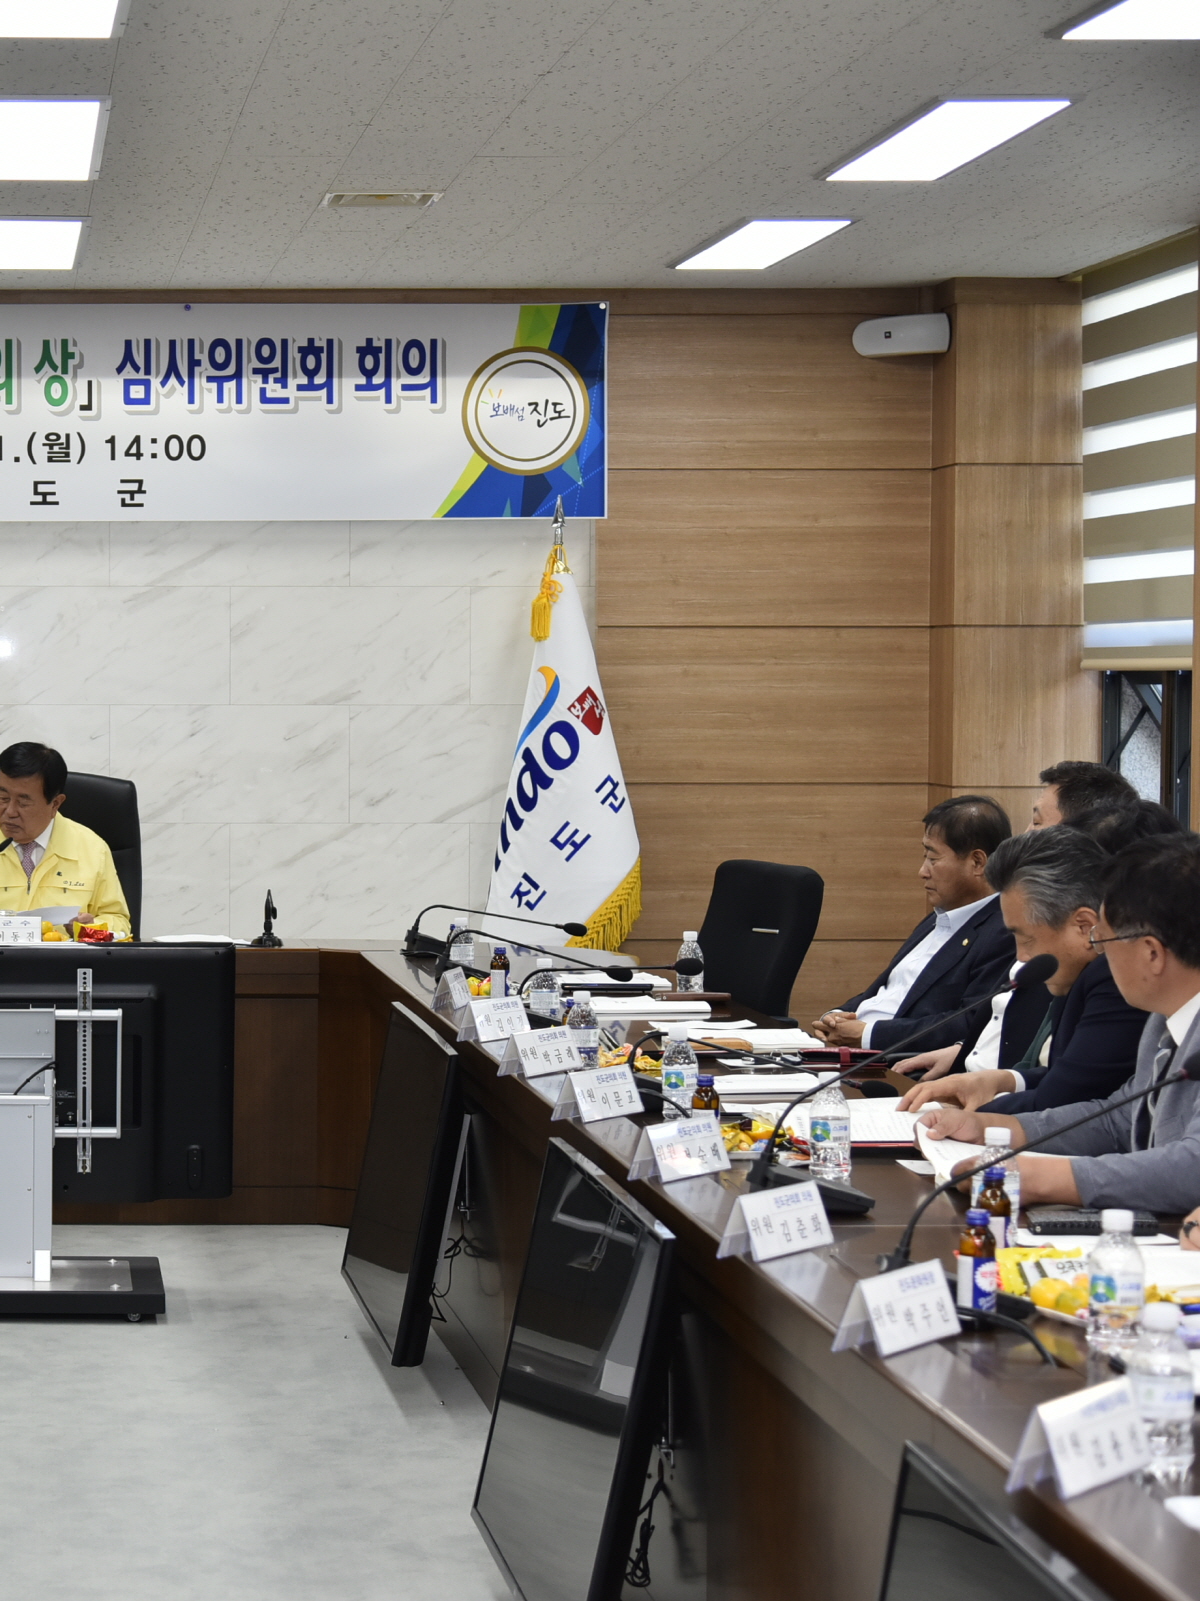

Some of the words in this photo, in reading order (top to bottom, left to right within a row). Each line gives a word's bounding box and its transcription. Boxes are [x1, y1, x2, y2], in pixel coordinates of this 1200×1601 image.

[34, 337, 94, 412] 상」
[116, 337, 337, 407] 심사위원회
[355, 337, 440, 406] 회의
[490, 402, 525, 422] 보배섬
[527, 399, 571, 428] 진도
[105, 433, 208, 462] 14:00
[520, 1046, 538, 1061] 위원
[750, 1214, 774, 1237] 위원
